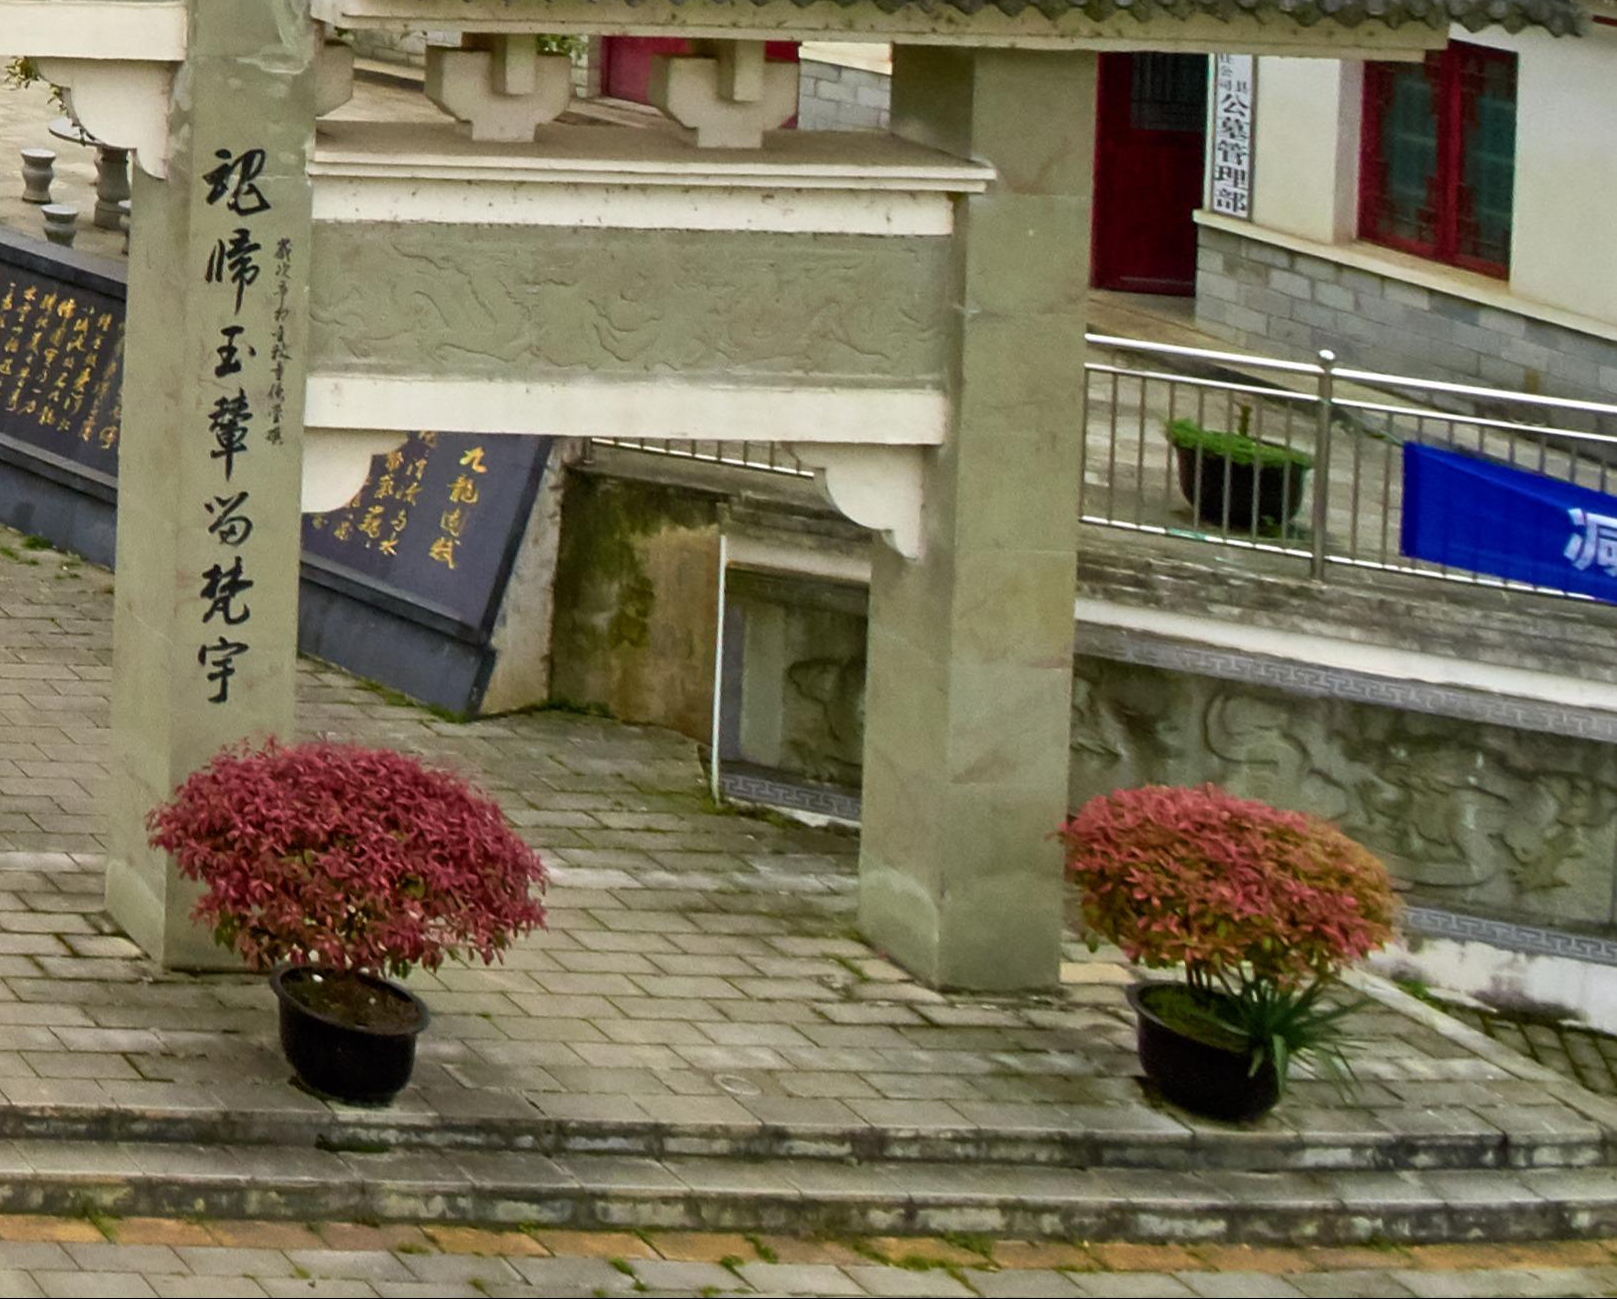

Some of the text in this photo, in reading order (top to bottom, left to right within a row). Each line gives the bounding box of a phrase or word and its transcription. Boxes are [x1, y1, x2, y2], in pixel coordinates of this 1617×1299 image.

[1214, 93, 1249, 213] 公墓管理部
